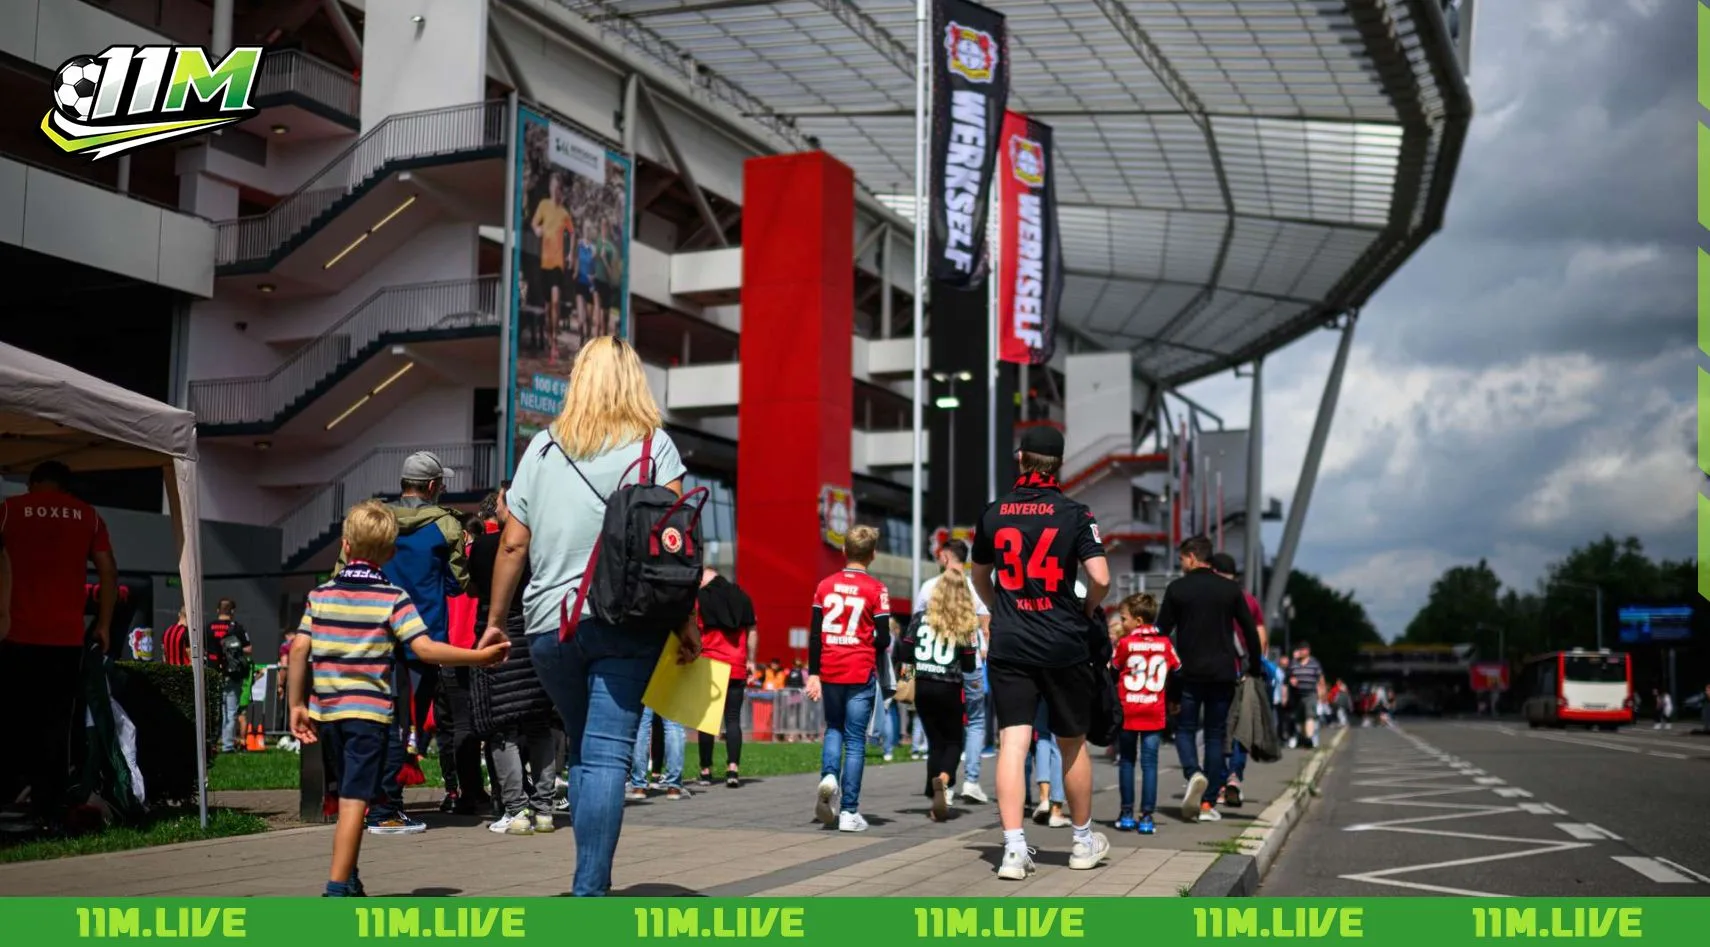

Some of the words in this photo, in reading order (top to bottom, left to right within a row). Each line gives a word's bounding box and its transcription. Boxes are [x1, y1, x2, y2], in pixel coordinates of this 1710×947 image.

[944, 90, 986, 274] WERKSELF
[1013, 193, 1043, 349] WERKSELF
[520, 391, 556, 413] NEUEN
[24, 506, 82, 520] BOXEN
[994, 527, 1064, 592] 34
[822, 592, 866, 637] 27
[914, 624, 957, 665] 30
[1123, 653, 1168, 693] 30
